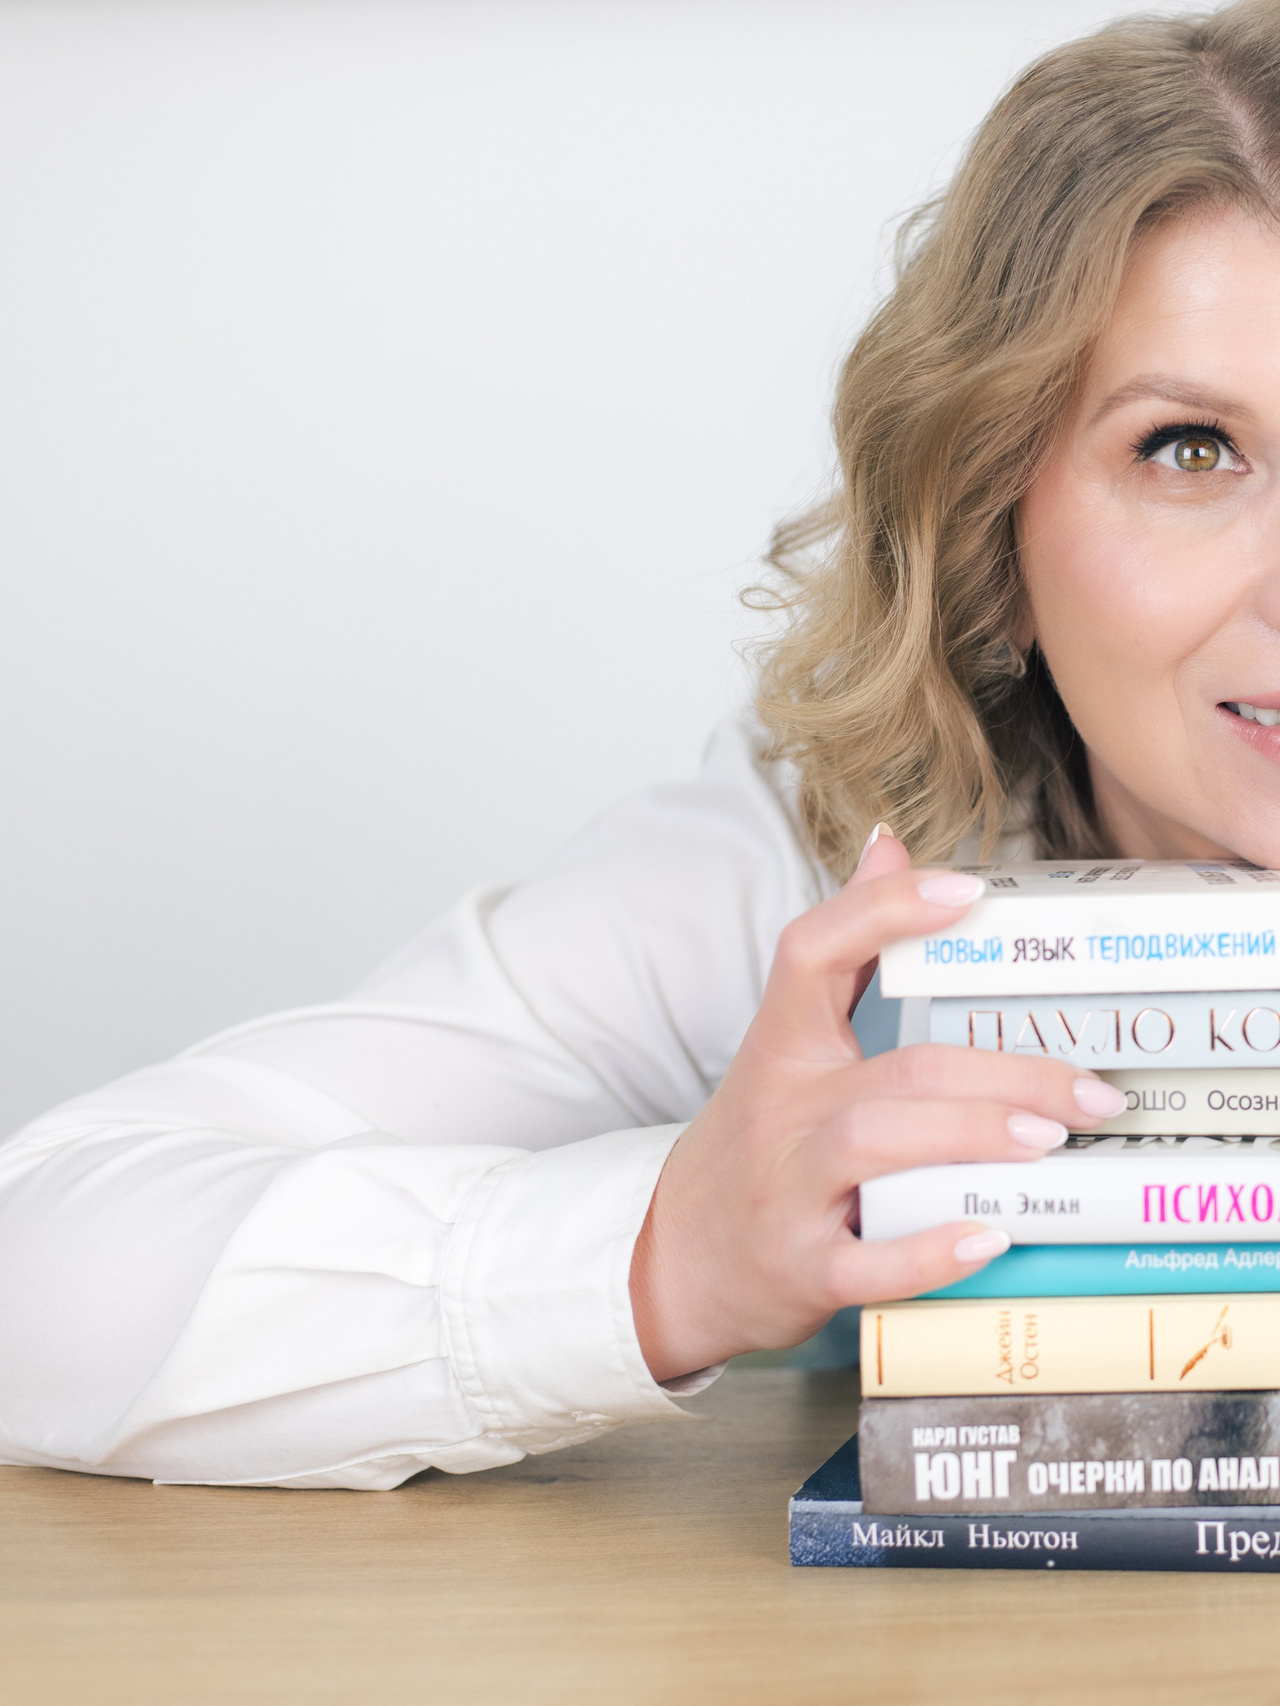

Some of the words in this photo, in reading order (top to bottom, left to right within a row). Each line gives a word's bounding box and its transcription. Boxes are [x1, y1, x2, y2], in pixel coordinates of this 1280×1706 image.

[924, 935, 1002, 966] НОВЫЙ
[1012, 936, 1076, 964] ЯЗЫК
[1086, 929, 1276, 964] ТЕЛОДВИЖЕНИЙ
[968, 1006, 1176, 1055] ПАУЛО
[1124, 1090, 1187, 1111] ОШО
[1125, 1248, 1219, 1273] Альфред
[995, 1310, 1015, 1385] Джейн
[1020, 1313, 1040, 1381] Остен
[912, 1427, 957, 1448] КАРЛ
[958, 1424, 1021, 1447] ГУСТАВ
[914, 1449, 1018, 1502] ЮНГ
[1026, 1459, 1146, 1496] ОЧЕРКИ
[1150, 1458, 1193, 1492] ПО
[851, 1521, 945, 1549] Майкл
[967, 1523, 1079, 1550] Ньютон
